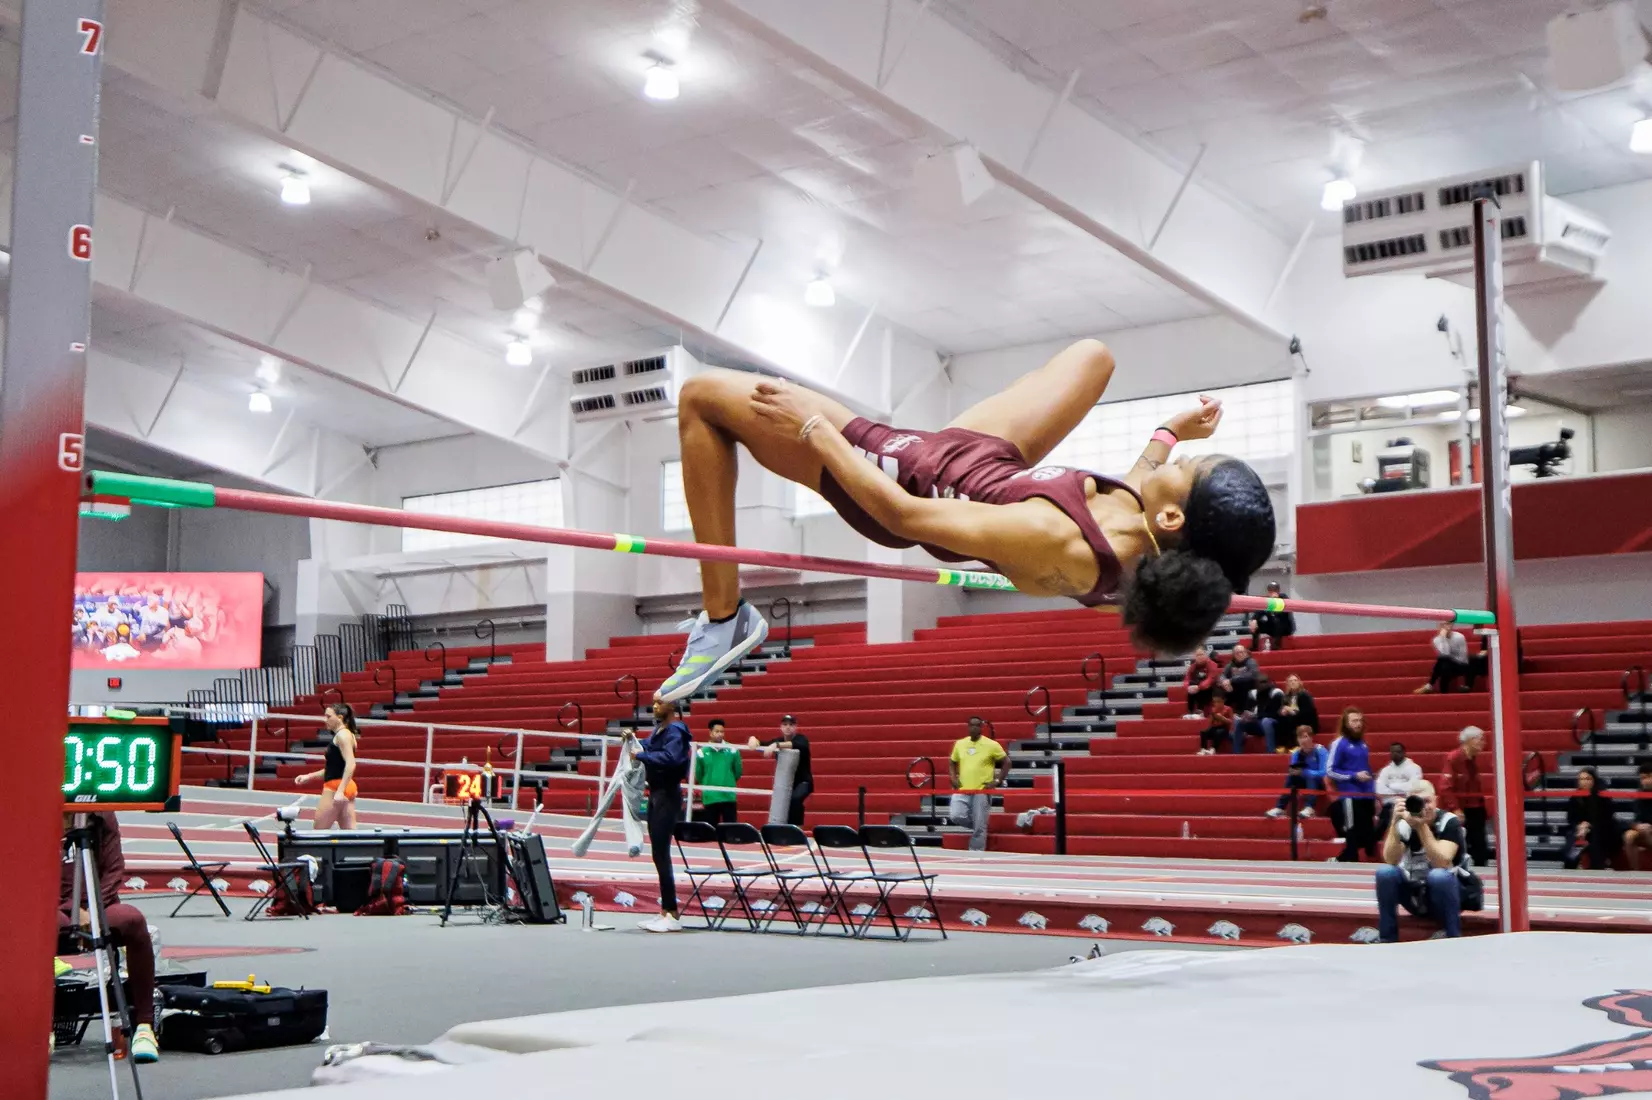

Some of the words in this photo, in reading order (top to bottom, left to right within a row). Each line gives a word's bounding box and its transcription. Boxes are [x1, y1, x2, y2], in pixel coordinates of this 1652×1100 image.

[78, 18, 103, 56] 7
[69, 224, 92, 261] 6
[59, 433, 84, 472] 5
[74, 794, 98, 803] GILL
[457, 774, 482, 798] 24
